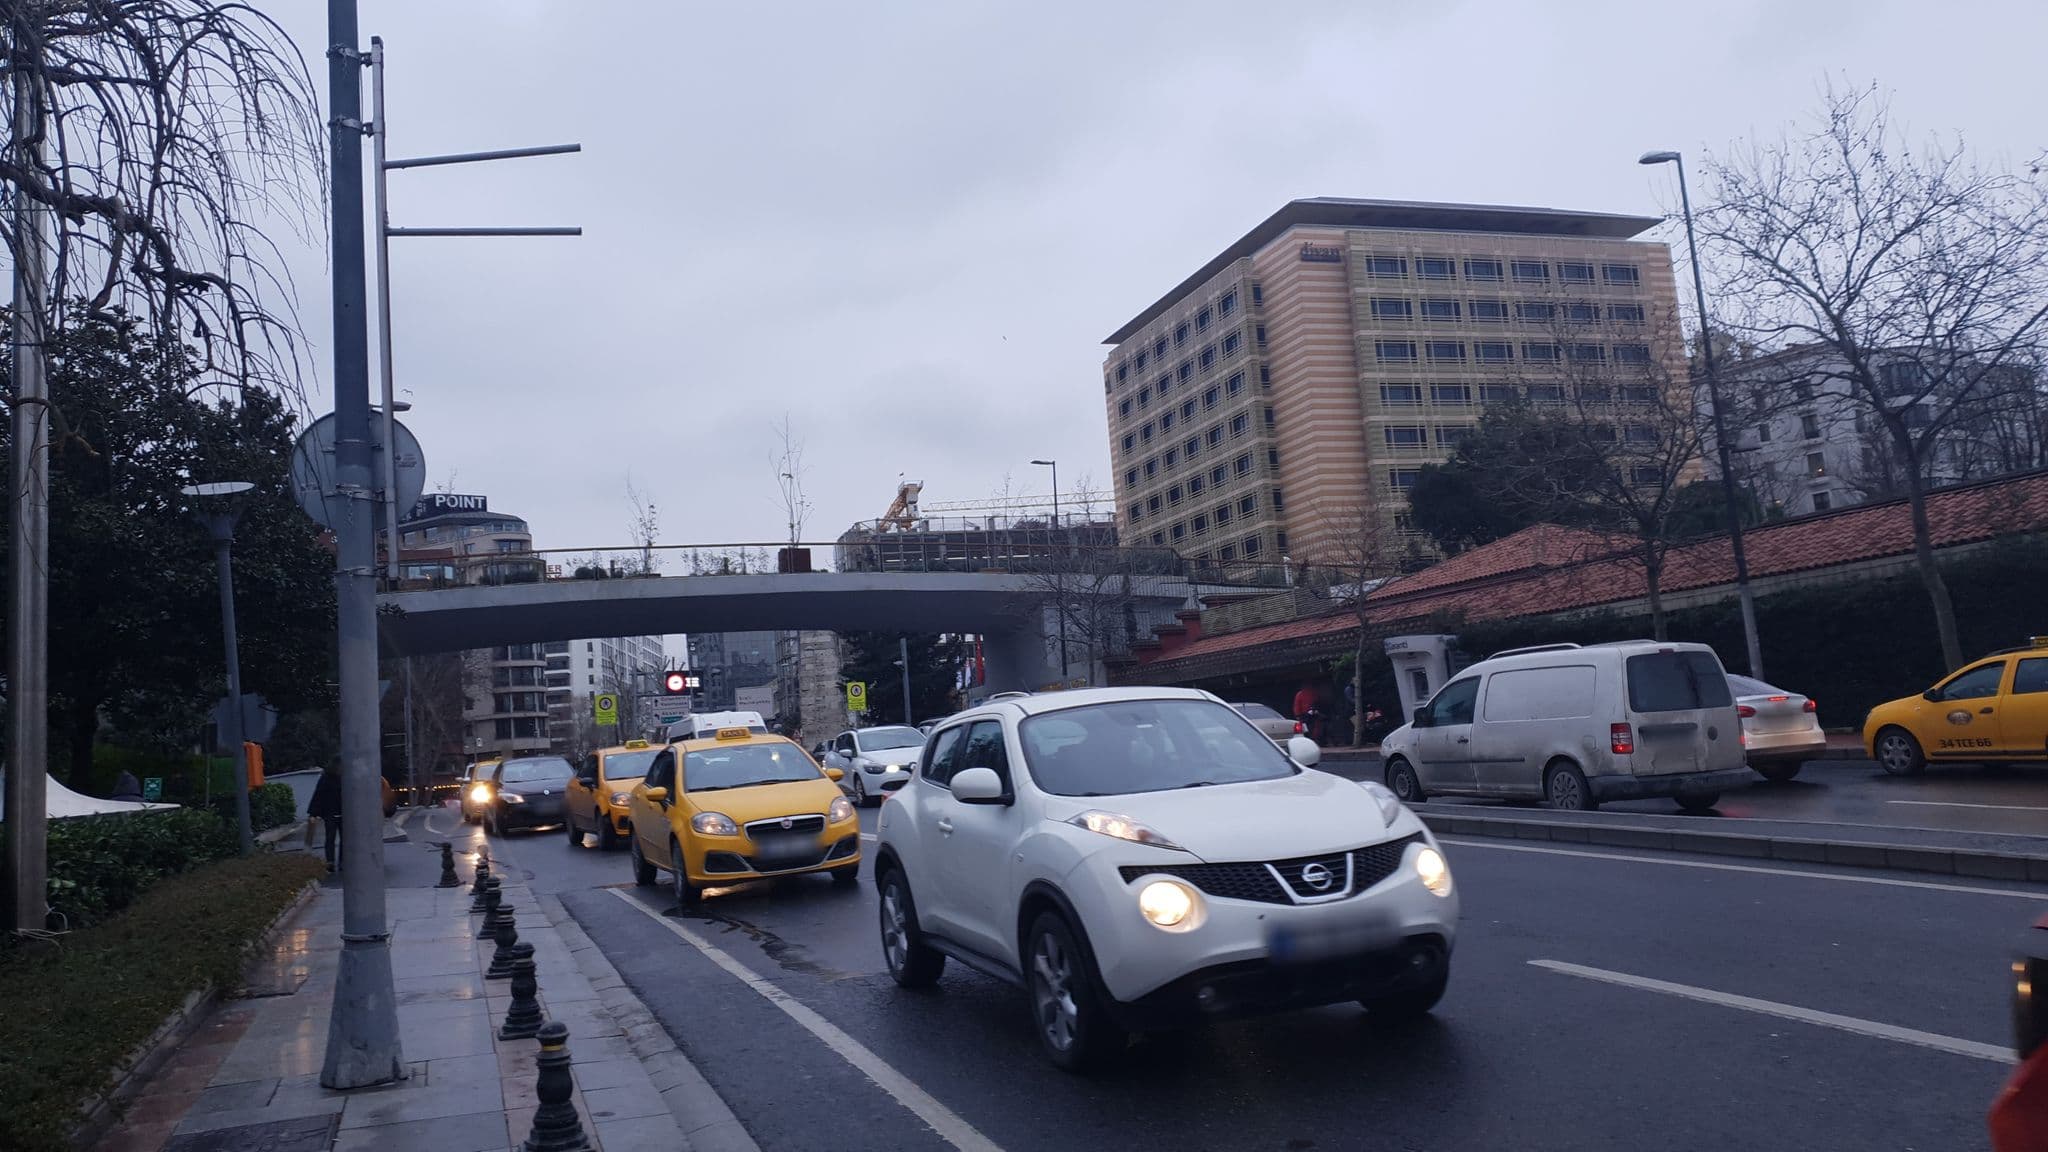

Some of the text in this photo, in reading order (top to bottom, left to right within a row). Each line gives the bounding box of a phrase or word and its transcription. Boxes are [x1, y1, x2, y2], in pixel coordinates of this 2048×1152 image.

[435, 494, 485, 509] POINT
[1939, 737, 1992, 748] 34 TCE 66
